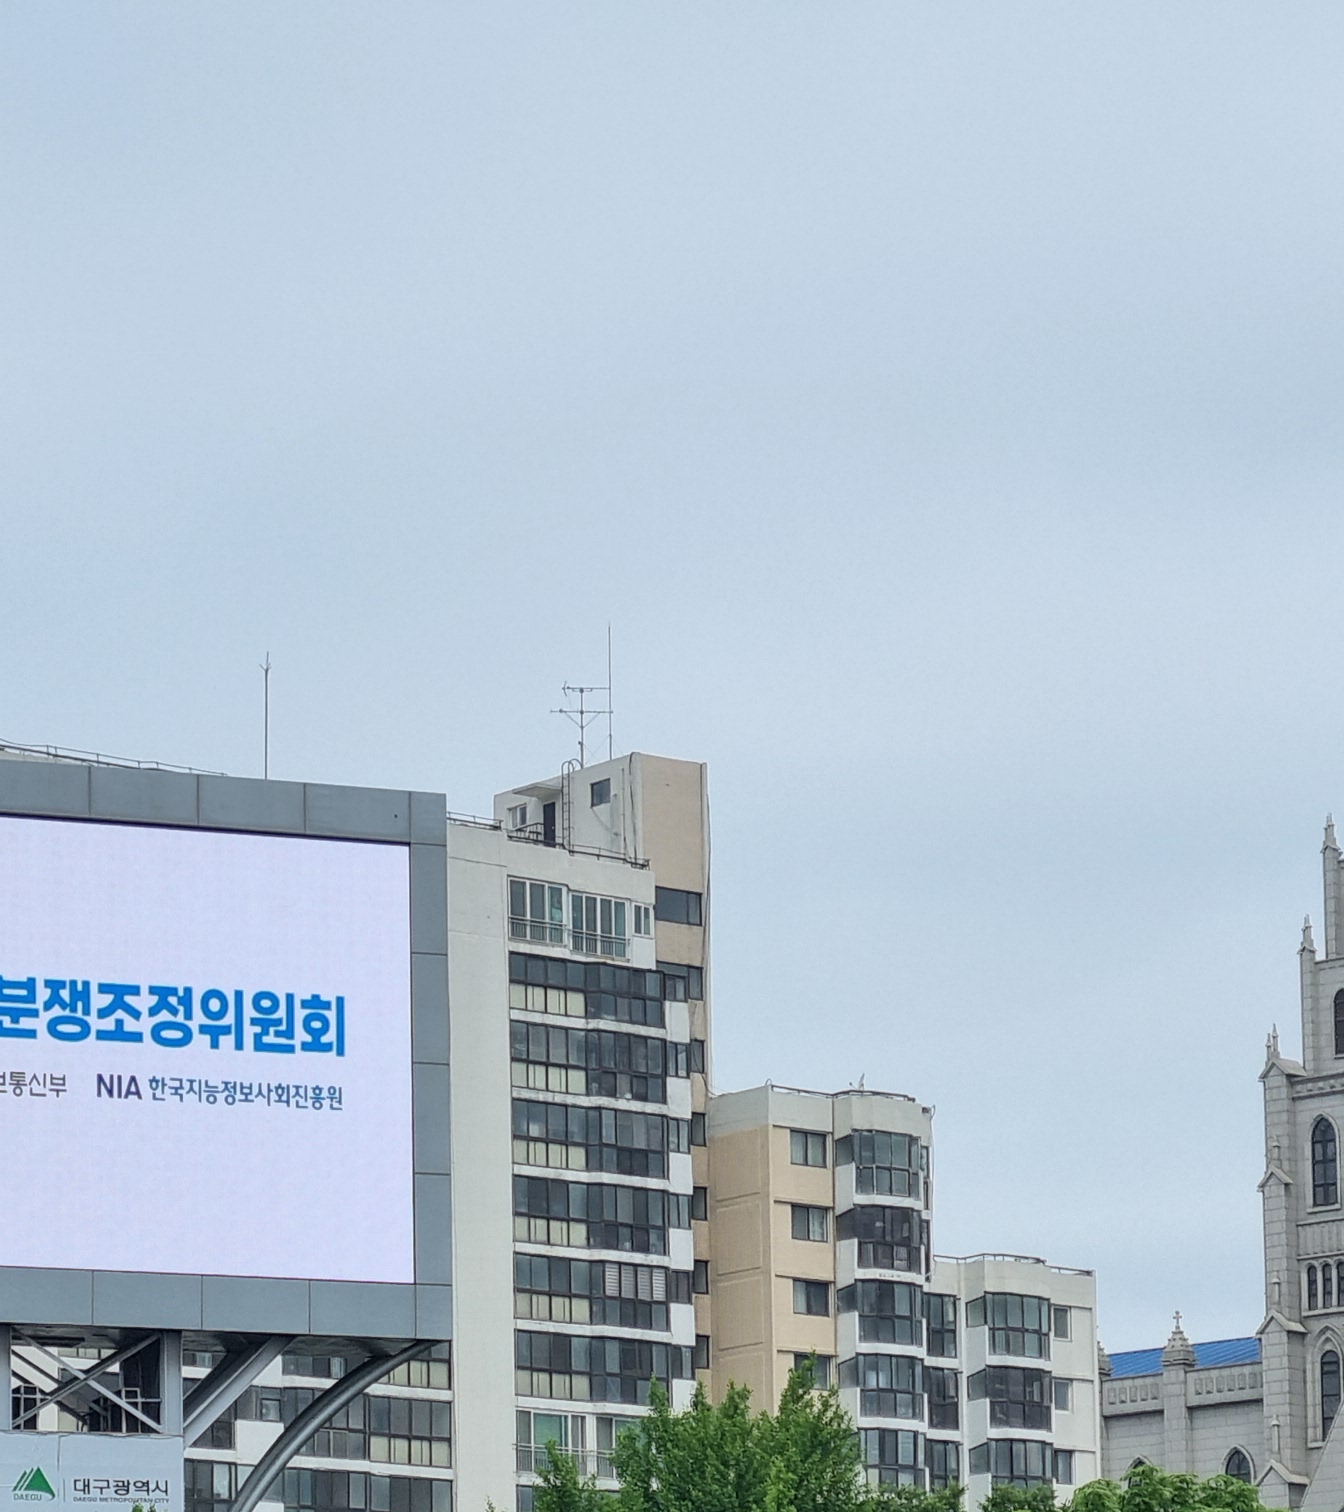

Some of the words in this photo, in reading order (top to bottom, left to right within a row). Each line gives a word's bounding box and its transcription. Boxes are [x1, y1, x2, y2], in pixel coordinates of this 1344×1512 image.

[96, 1074, 143, 1100] NIA
[147, 1077, 344, 1111] 한국지능정보사회진흥원
[74, 1478, 169, 1496] 대구광역시
[13, 1493, 43, 1501] DAEGU
